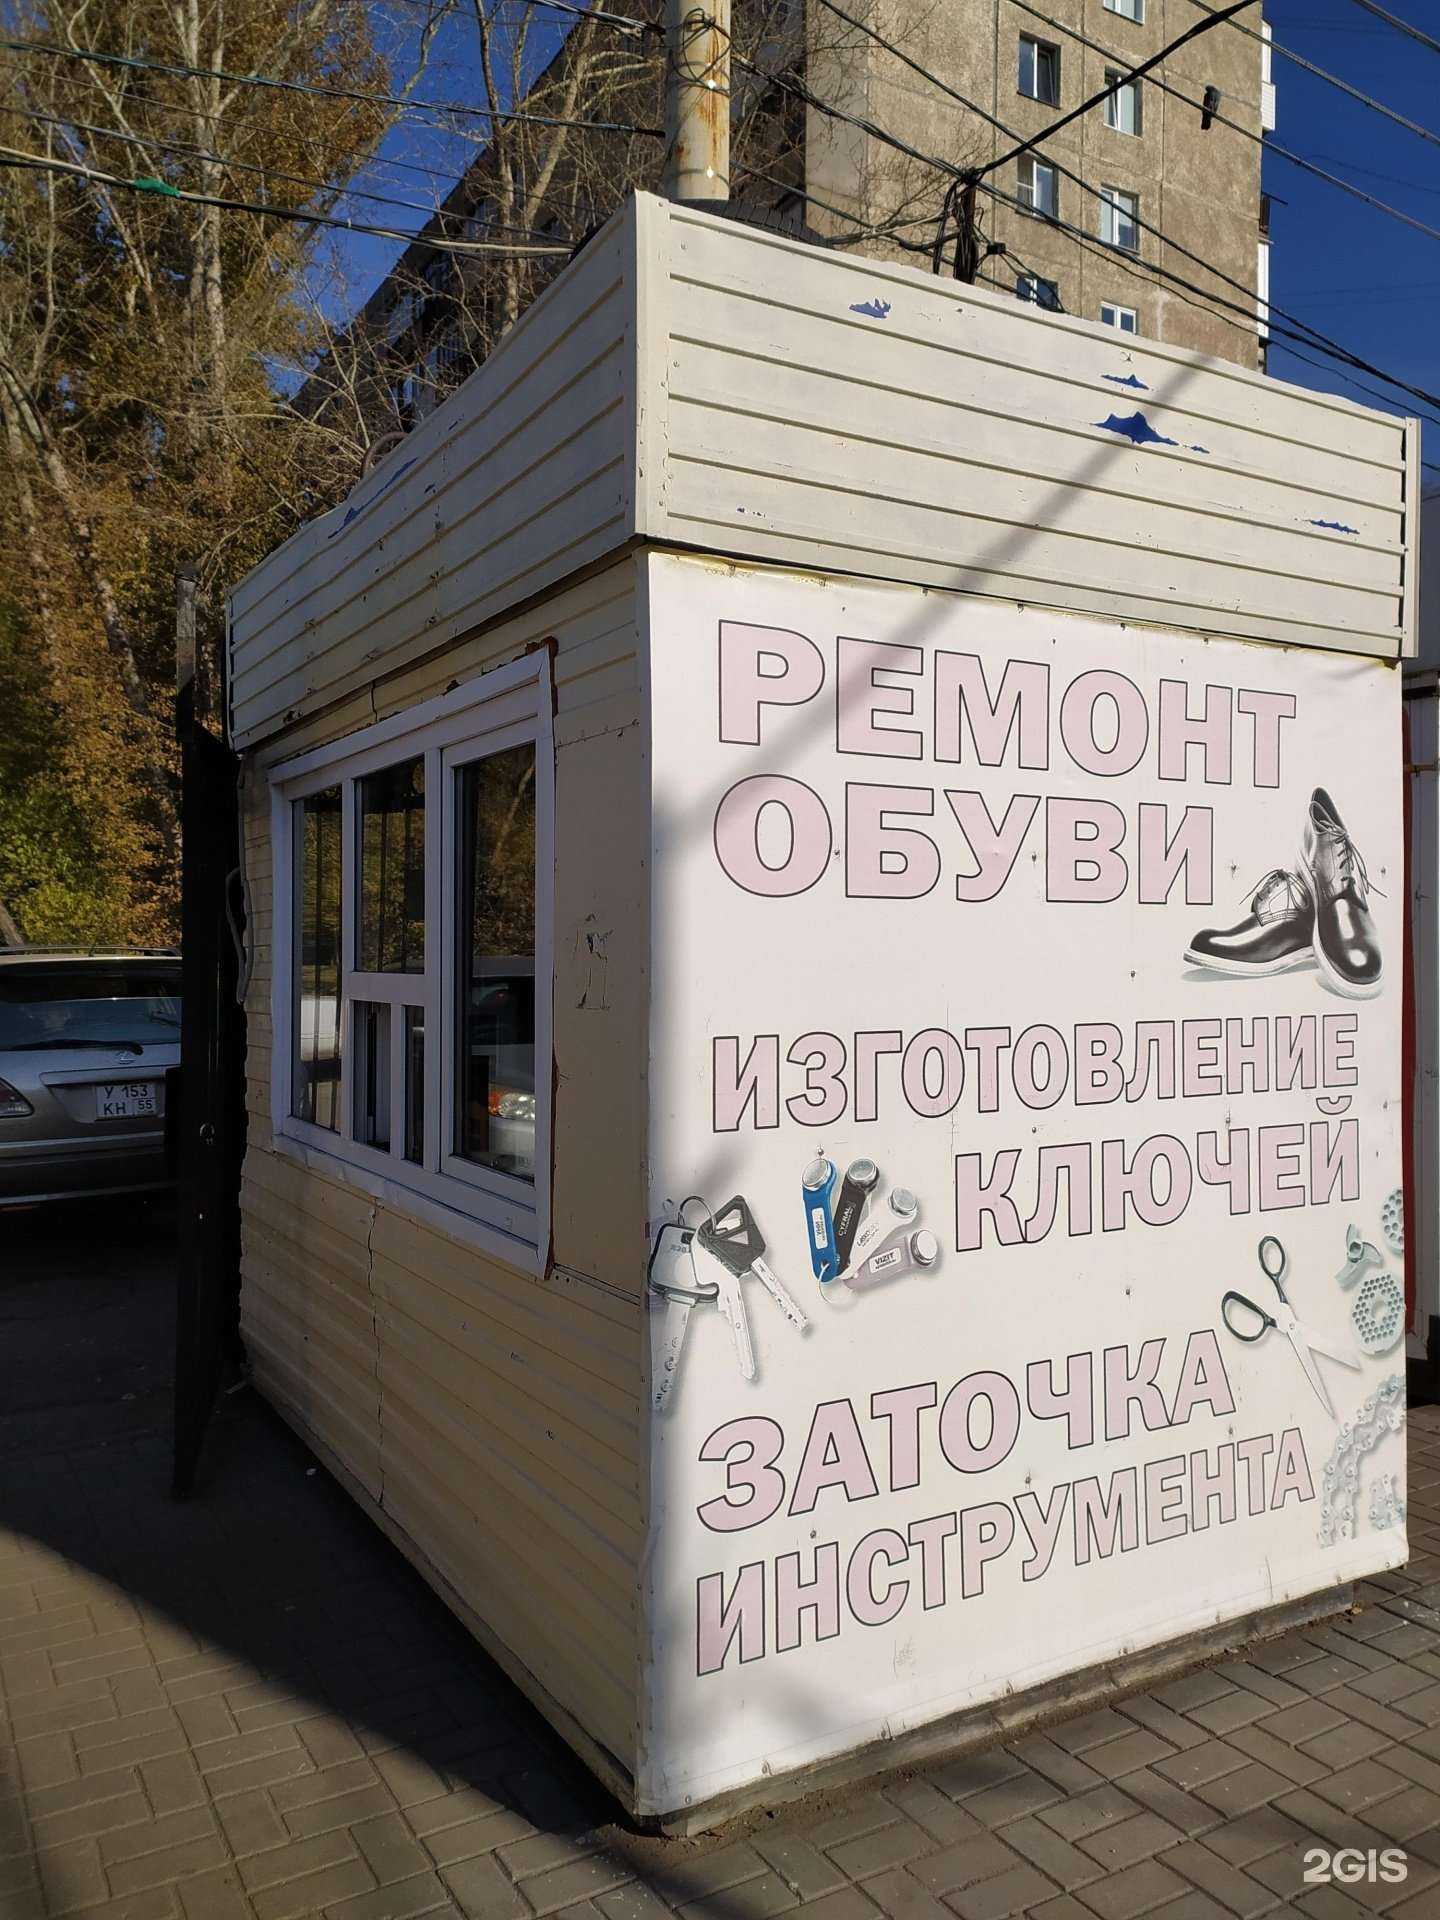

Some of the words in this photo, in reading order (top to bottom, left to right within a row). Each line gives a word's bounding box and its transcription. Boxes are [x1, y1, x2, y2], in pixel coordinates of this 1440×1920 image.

[718, 619, 1297, 789] РЕМОНТ
[713, 773, 1214, 906] ОБУВИ
[121, 1084, 148, 1098] 153
[138, 1099, 153, 1110] 55
[712, 1013, 1360, 1134] ИЗГОТОВЛЕНИЕ
[955, 1095, 1360, 1253] КЛЮЧЕЙ
[874, 1252, 894, 1266] VIZIT
[696, 1329, 1237, 1533] ЗАТОЧКА
[696, 1427, 1317, 1677] ИНСТРУМЕНТА
